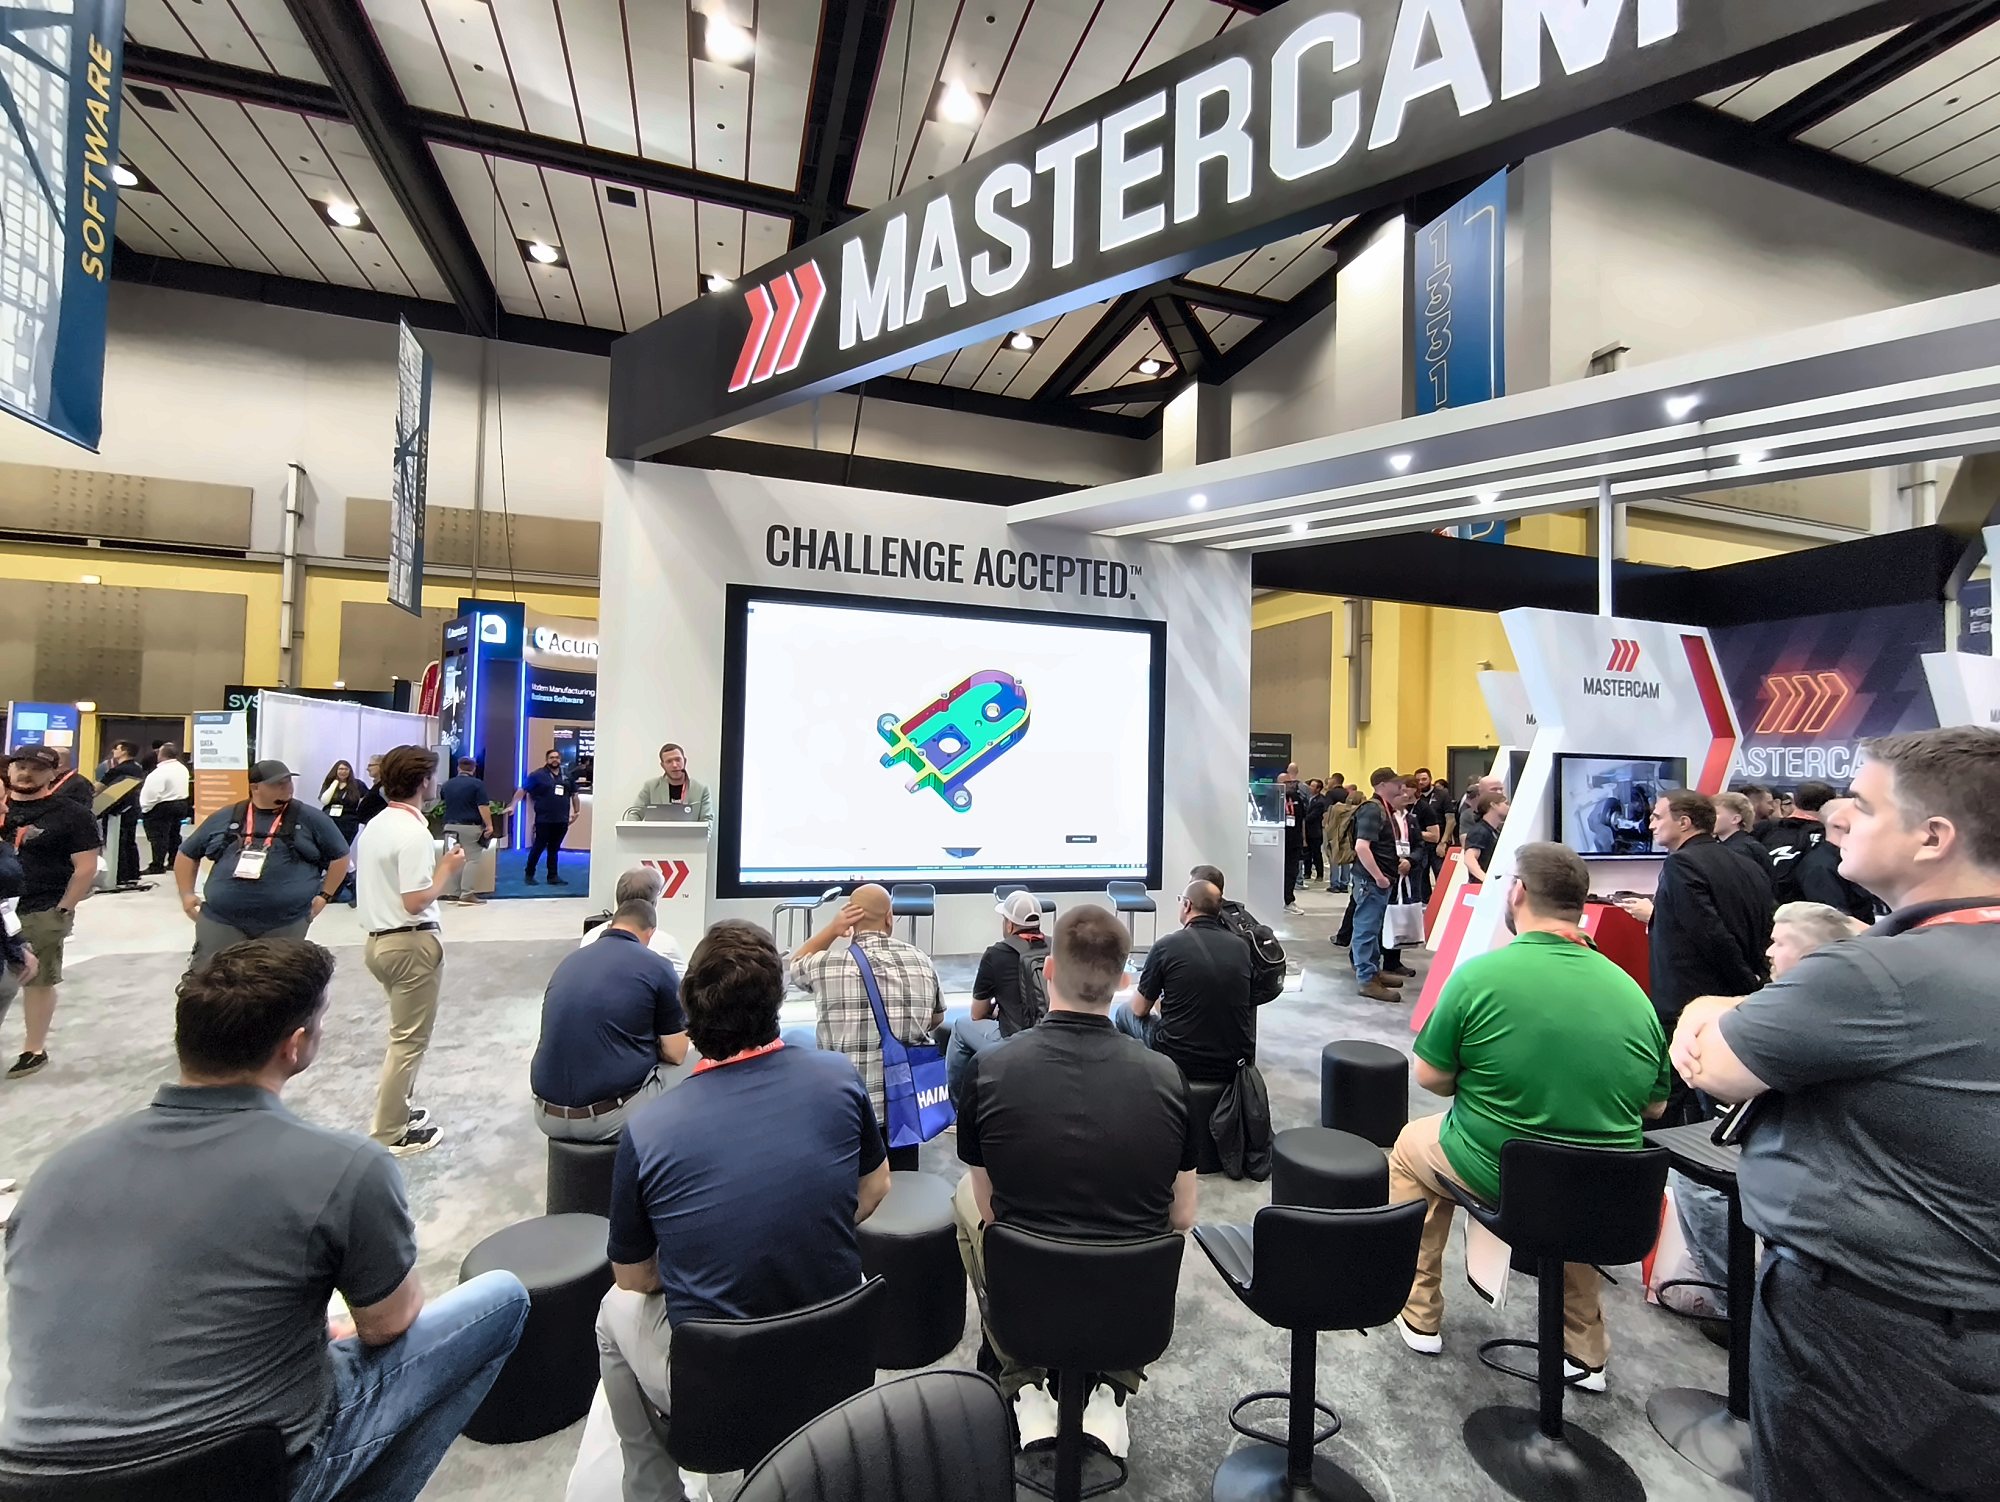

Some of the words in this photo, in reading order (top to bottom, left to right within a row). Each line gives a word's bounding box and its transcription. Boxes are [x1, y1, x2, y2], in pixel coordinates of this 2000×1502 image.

[81, 33, 113, 282] SOFTWARE
[1425, 220, 1452, 411] 1331
[417, 430, 429, 540] SOFTWARE
[766, 524, 965, 584] CHALLENGE
[549, 685, 595, 697] Manufacturing
[553, 694, 584, 704] Software
[1583, 677, 1661, 699] MASTERCAM
[1732, 744, 1865, 779] ASTERCA
